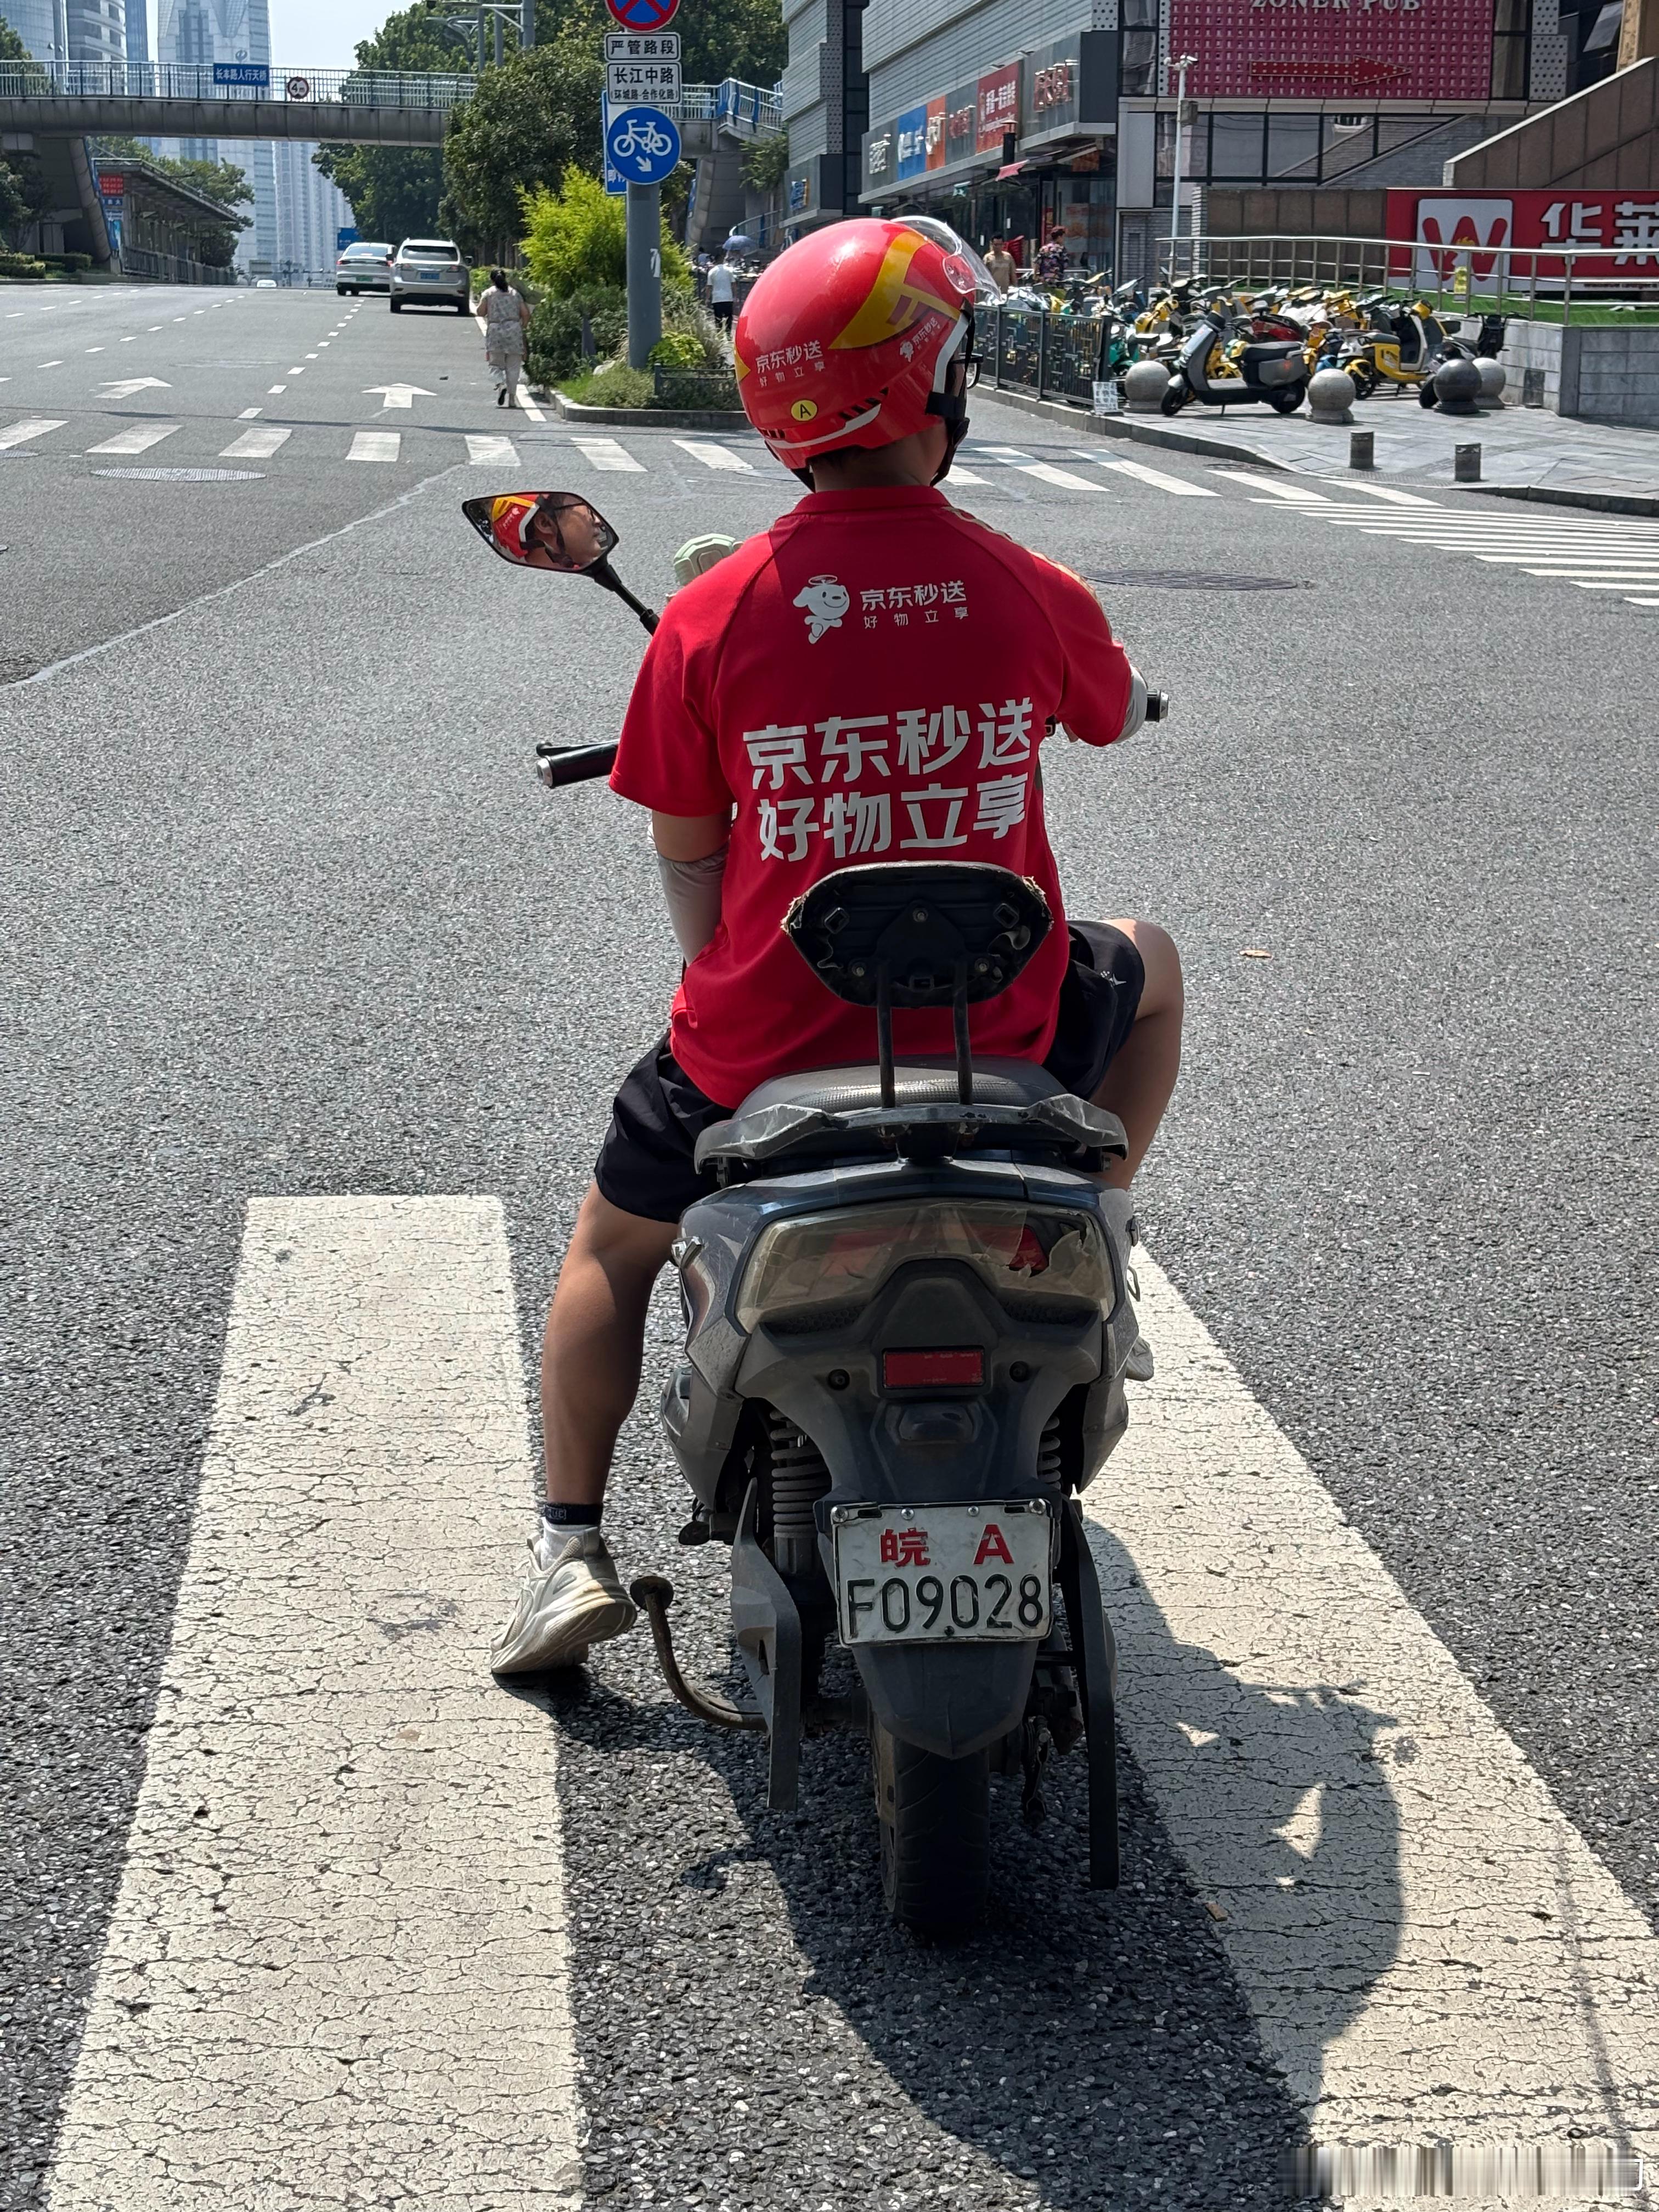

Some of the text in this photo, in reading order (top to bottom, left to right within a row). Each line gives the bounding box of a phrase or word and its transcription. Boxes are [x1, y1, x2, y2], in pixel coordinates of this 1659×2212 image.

[611, 40, 675, 55] 严管路段
[613, 67, 674, 84] 长江中路
[1541, 201, 1659, 265] 华莱
[755, 340, 823, 374] 京东秒送
[800, 404, 811, 419] A
[860, 580, 967, 611] 京东秒送
[864, 607, 969, 629] 好物立享
[743, 697, 1033, 790] 京东秒送
[757, 772, 1029, 862] 好物立享
[879, 1524, 1014, 1567] 皖 A
[847, 1573, 1043, 1639] F09028
